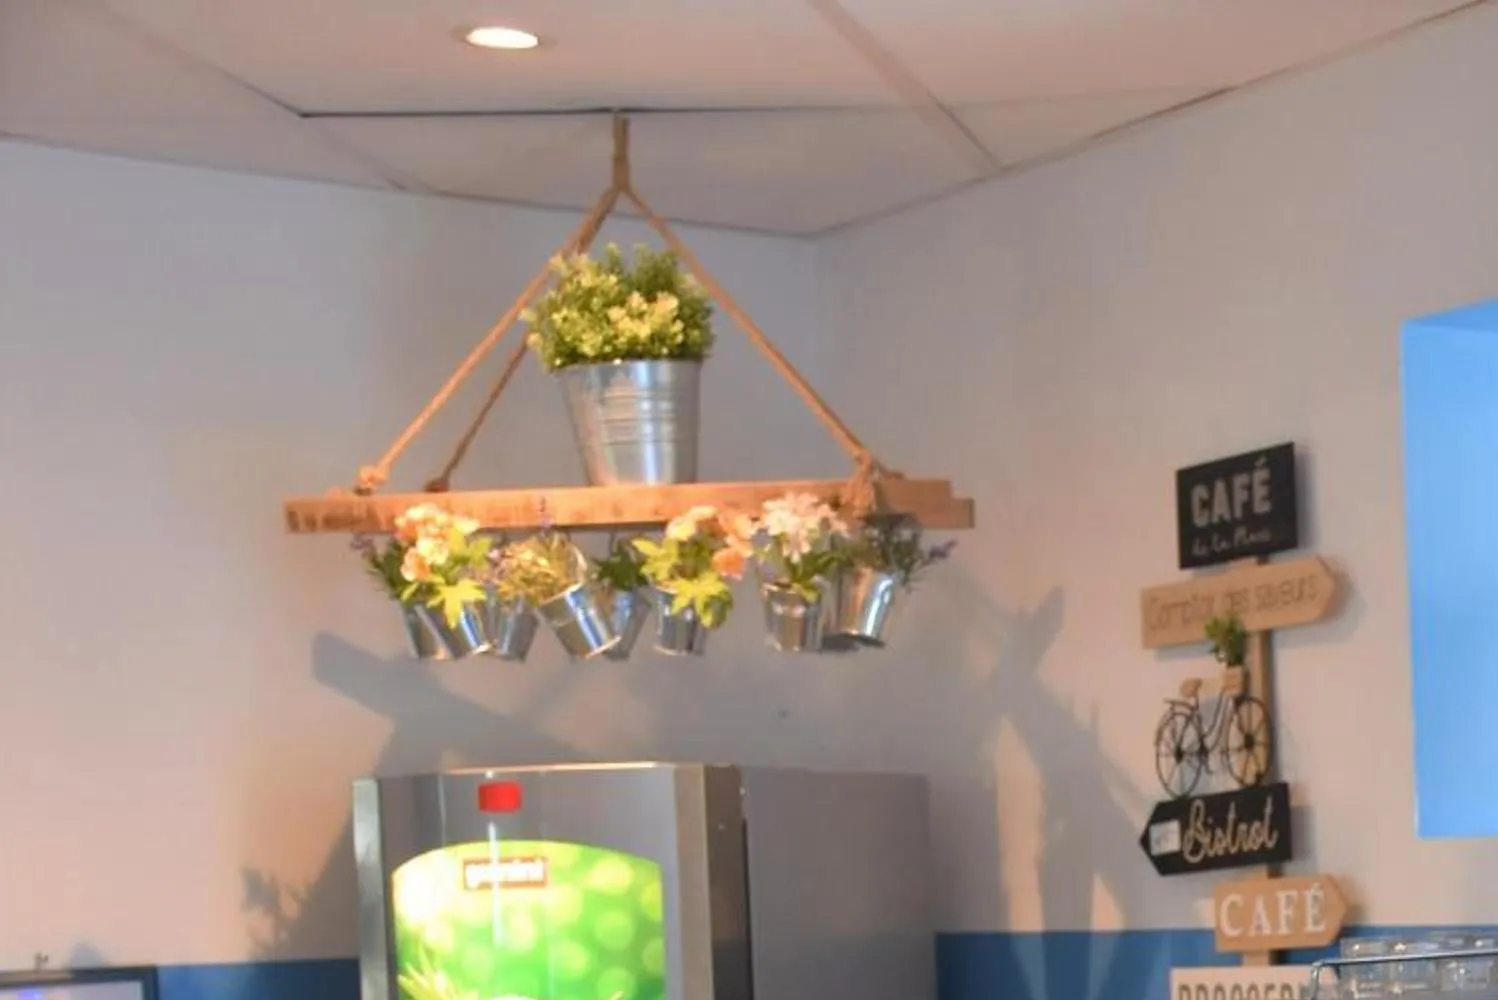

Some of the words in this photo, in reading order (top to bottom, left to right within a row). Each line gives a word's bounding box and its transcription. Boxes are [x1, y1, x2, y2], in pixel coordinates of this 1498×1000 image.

[1191, 455, 1271, 528] CAFÉ
[1183, 796, 1279, 863] Bistrot
[1220, 882, 1326, 938] CAFÉ
